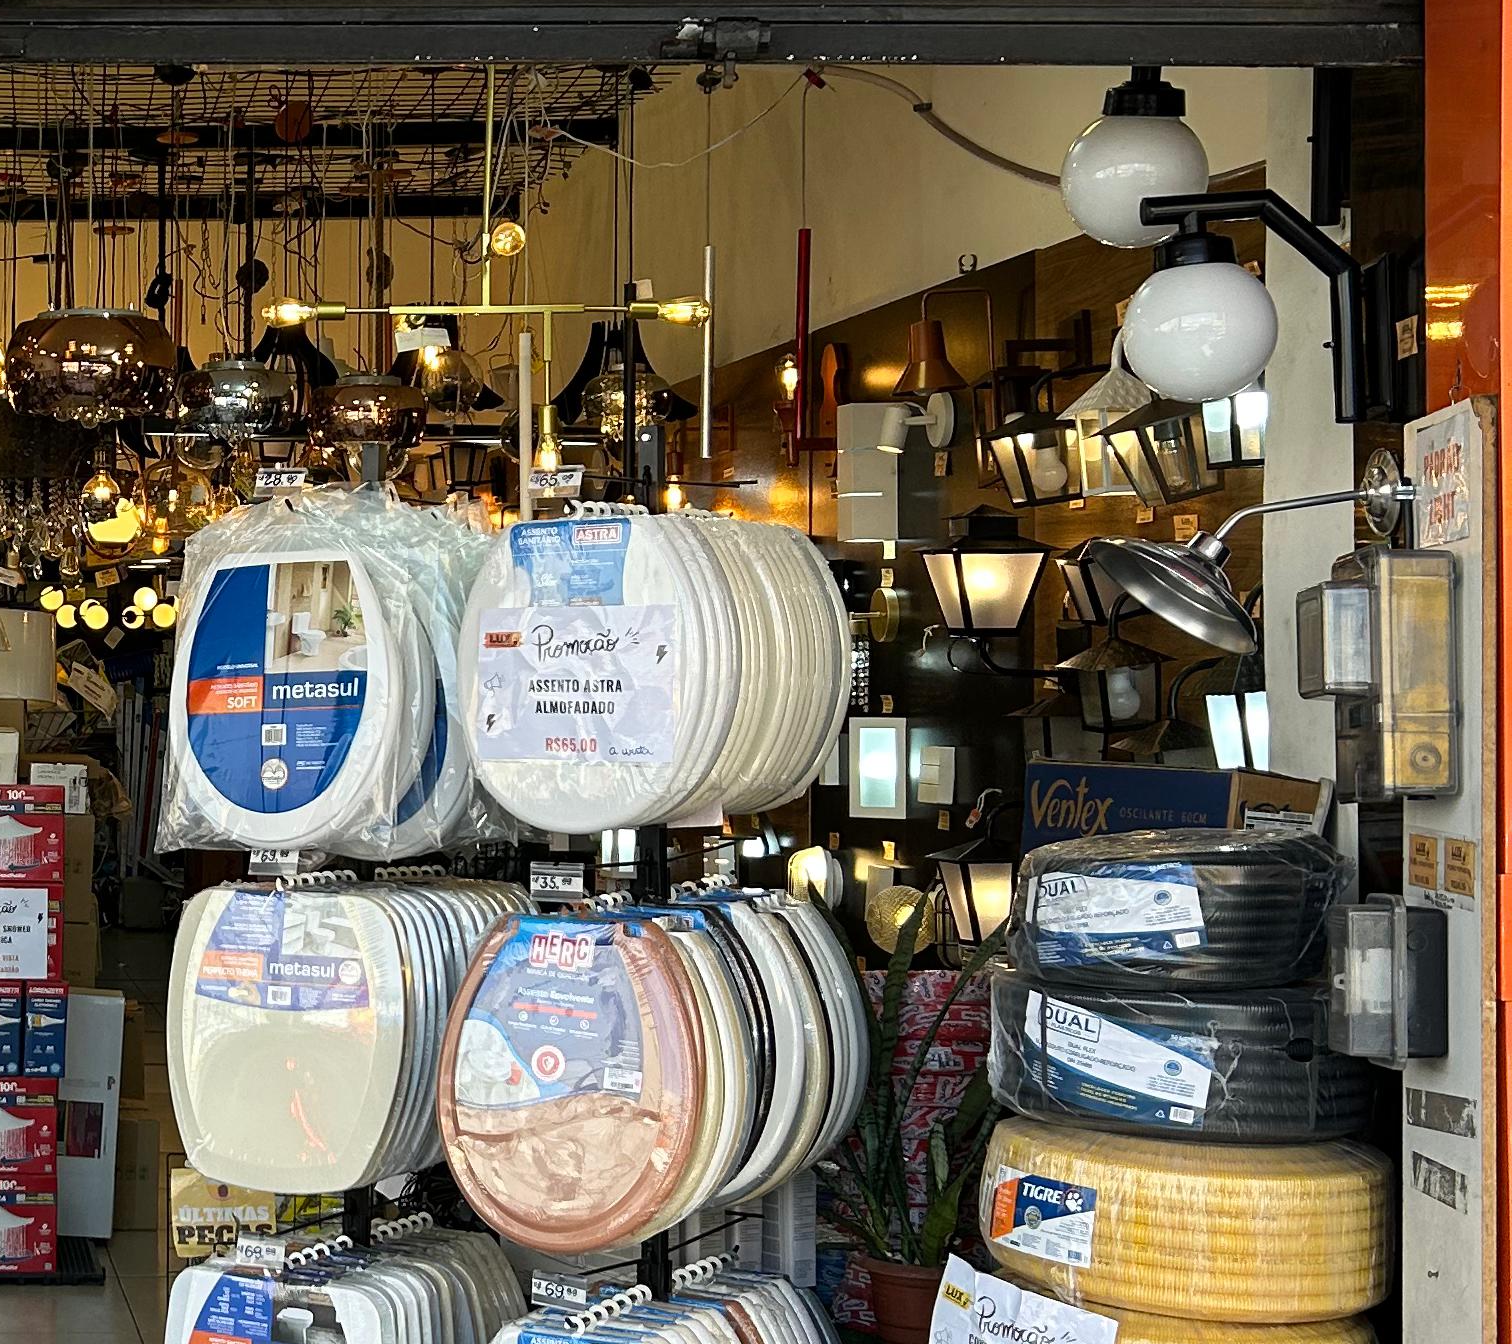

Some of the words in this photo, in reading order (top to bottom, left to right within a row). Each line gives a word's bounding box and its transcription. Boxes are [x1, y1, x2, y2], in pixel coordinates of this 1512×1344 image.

[576, 527, 620, 541] ASTRA
[531, 624, 620, 663] Promoção
[272, 677, 359, 700] metasul
[528, 679, 580, 693] ASSENTO
[583, 679, 623, 694] ASTRA
[227, 695, 258, 709] SOFT
[534, 700, 616, 715] ALMOFADADO
[544, 737, 598, 754] R$65,00
[1029, 776, 1116, 838] Ventex
[530, 933, 591, 968] HERC
[269, 960, 336, 978] metasul
[28, 986, 64, 995] LORENZETTI
[1023, 1182, 1064, 1205] TIGRE
[945, 1284, 963, 1305] LUX
